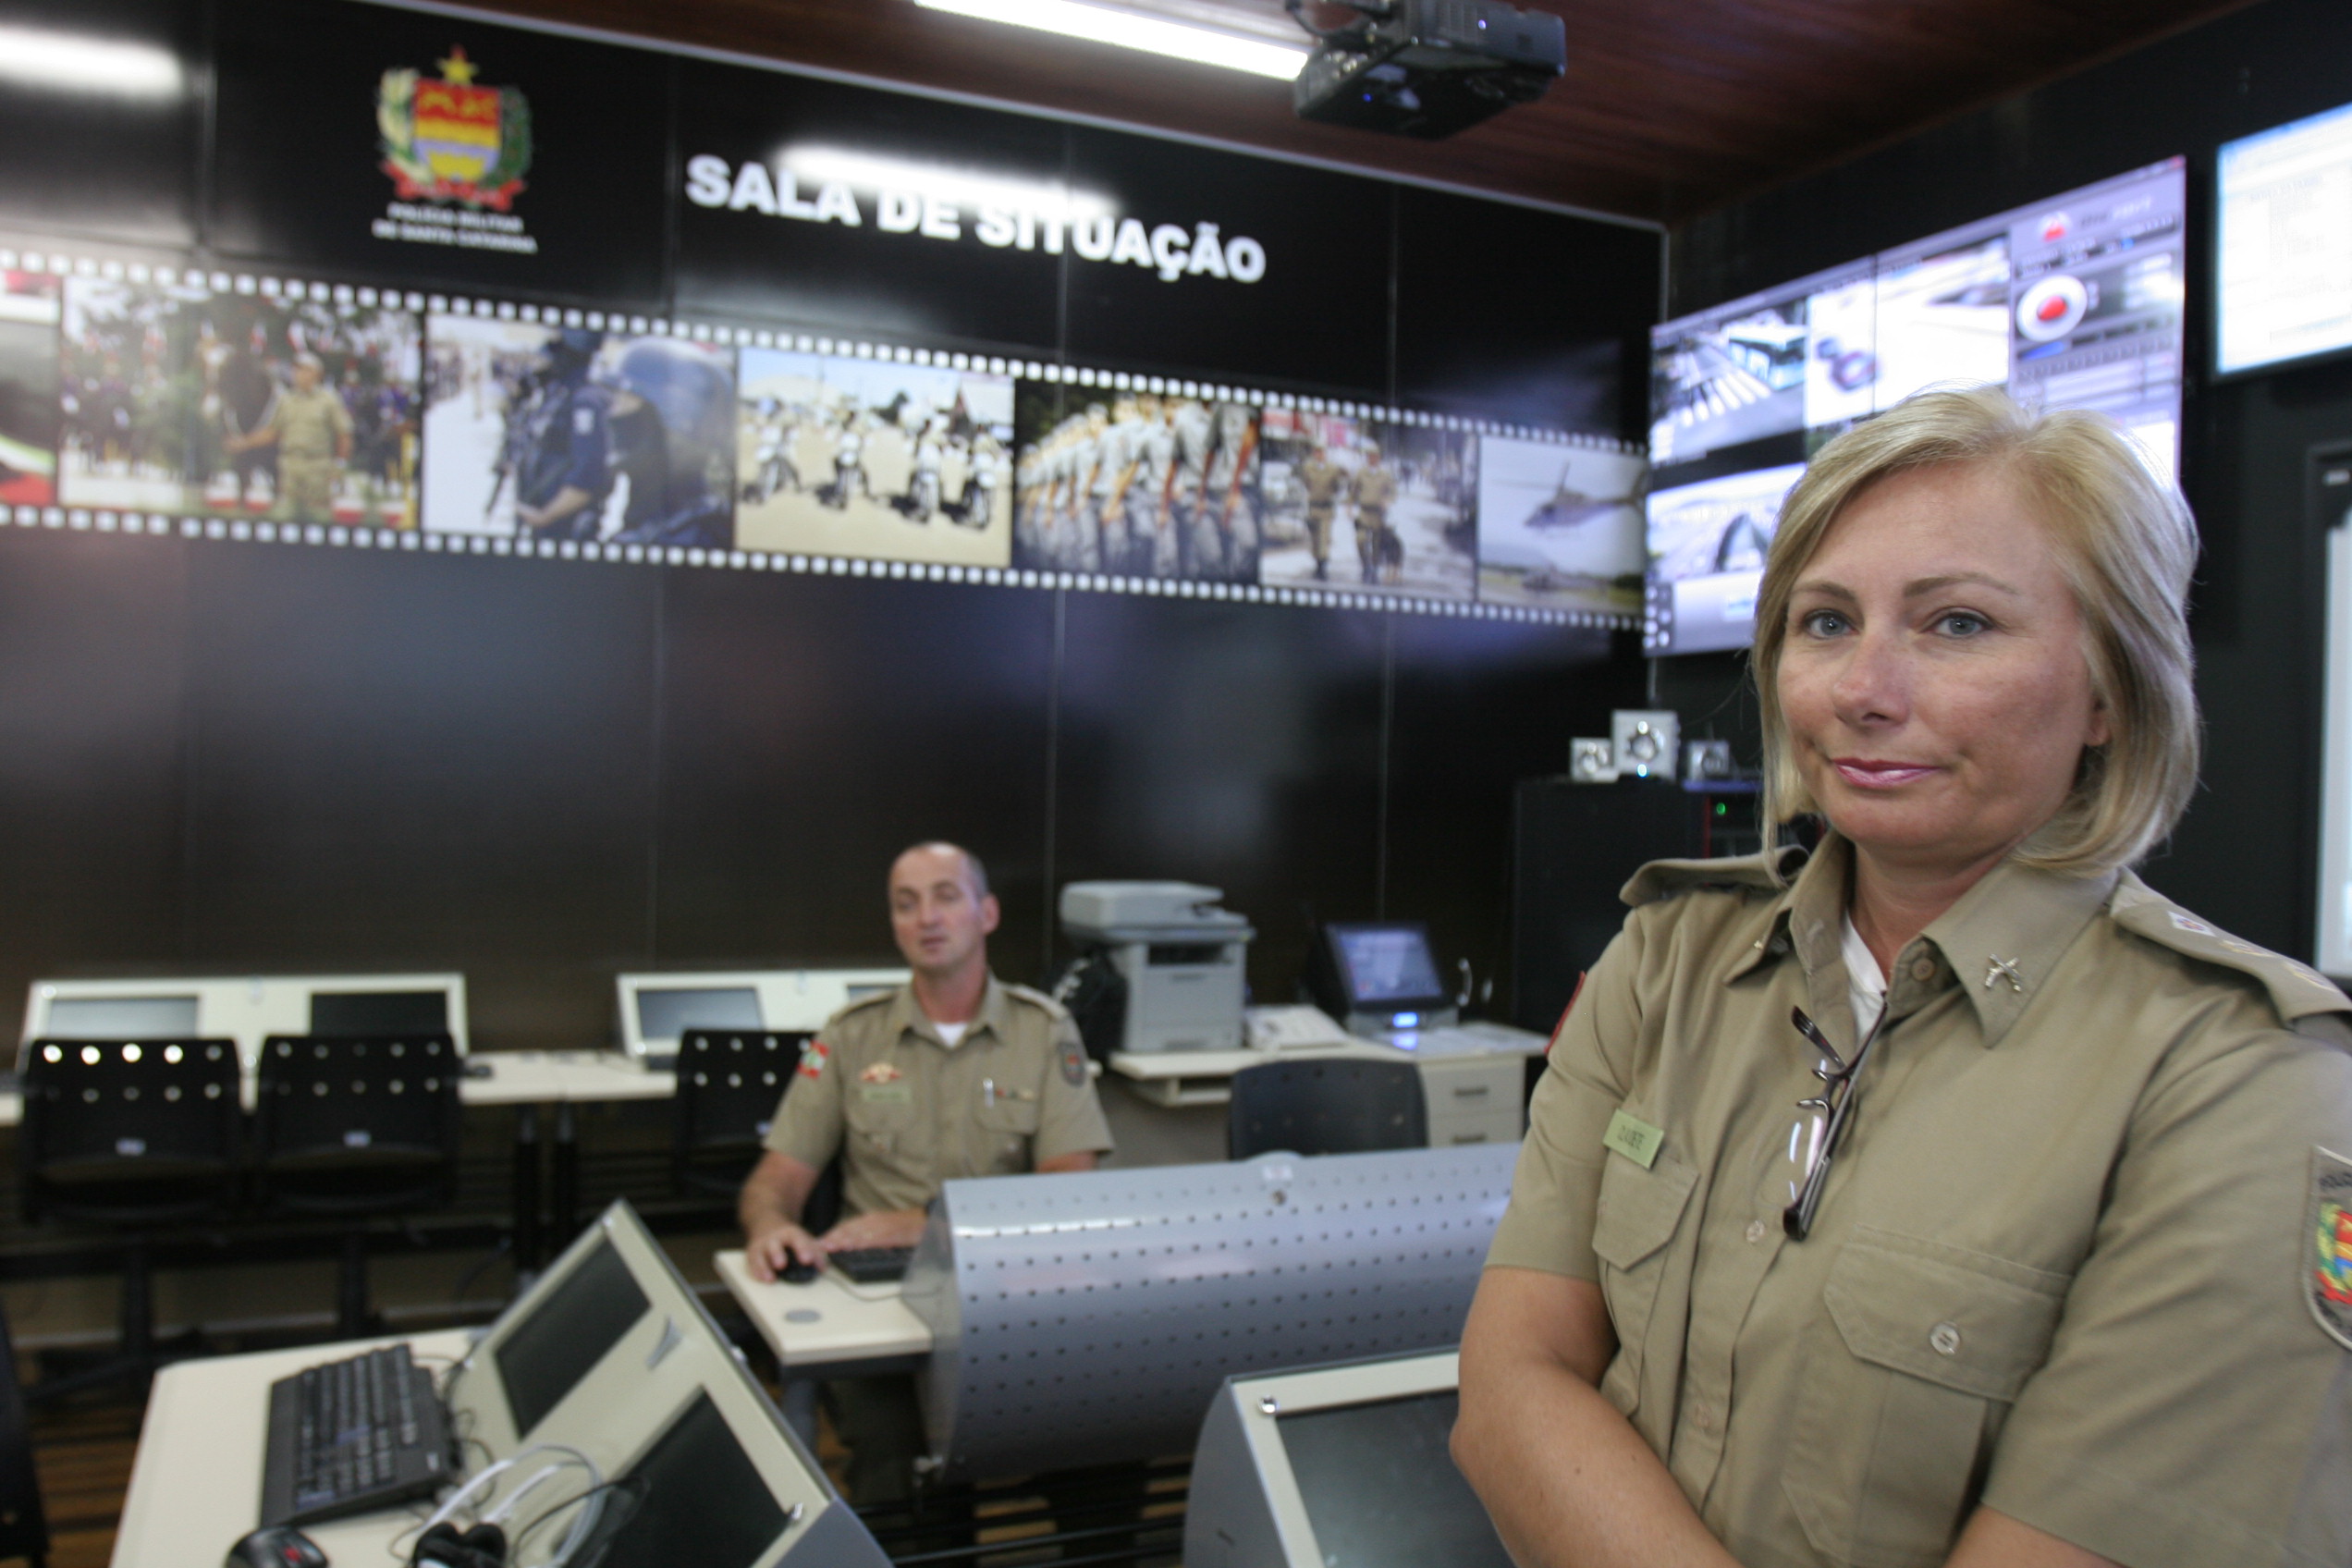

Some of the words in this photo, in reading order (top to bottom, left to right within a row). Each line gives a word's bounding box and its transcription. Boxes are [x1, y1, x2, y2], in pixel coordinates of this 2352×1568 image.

[685, 154, 862, 227] SALA
[876, 188, 961, 240] DE
[974, 205, 1267, 283] SITUAÇÃO
